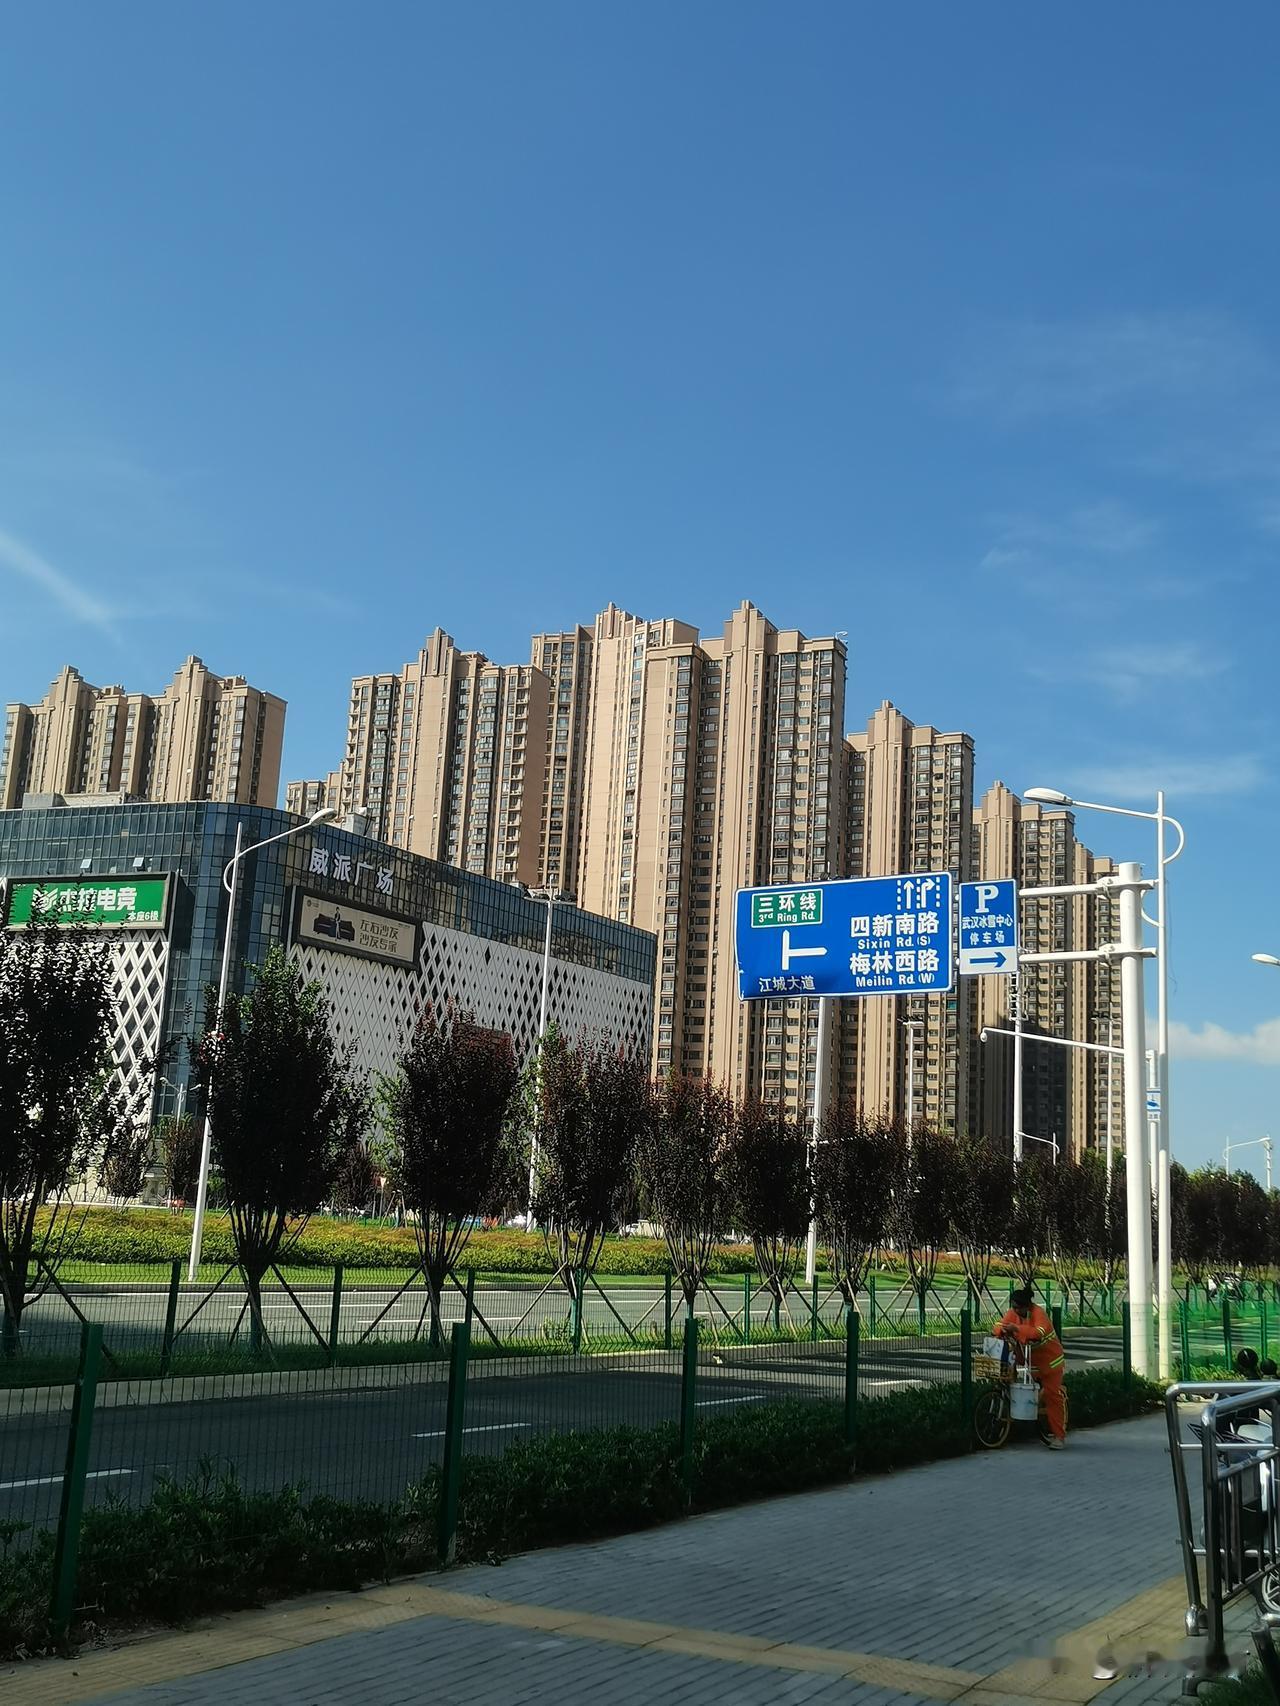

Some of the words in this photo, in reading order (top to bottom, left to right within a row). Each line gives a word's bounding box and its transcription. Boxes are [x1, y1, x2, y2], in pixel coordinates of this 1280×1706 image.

[308, 847, 395, 895] 威派广场
[758, 892, 817, 913] 三环线
[975, 885, 998, 913] P
[758, 912, 773, 923] 3rd
[777, 912, 797, 923] Ring
[850, 912, 940, 938] 四新南路
[961, 913, 1013, 929] 武汉冰雪中心
[857, 938, 891, 949] Sixin
[969, 930, 1005, 946] 停车场
[849, 949, 940, 975] 梅林西路
[758, 975, 816, 993] 江城大道
[856, 976, 893, 988] Meilin
